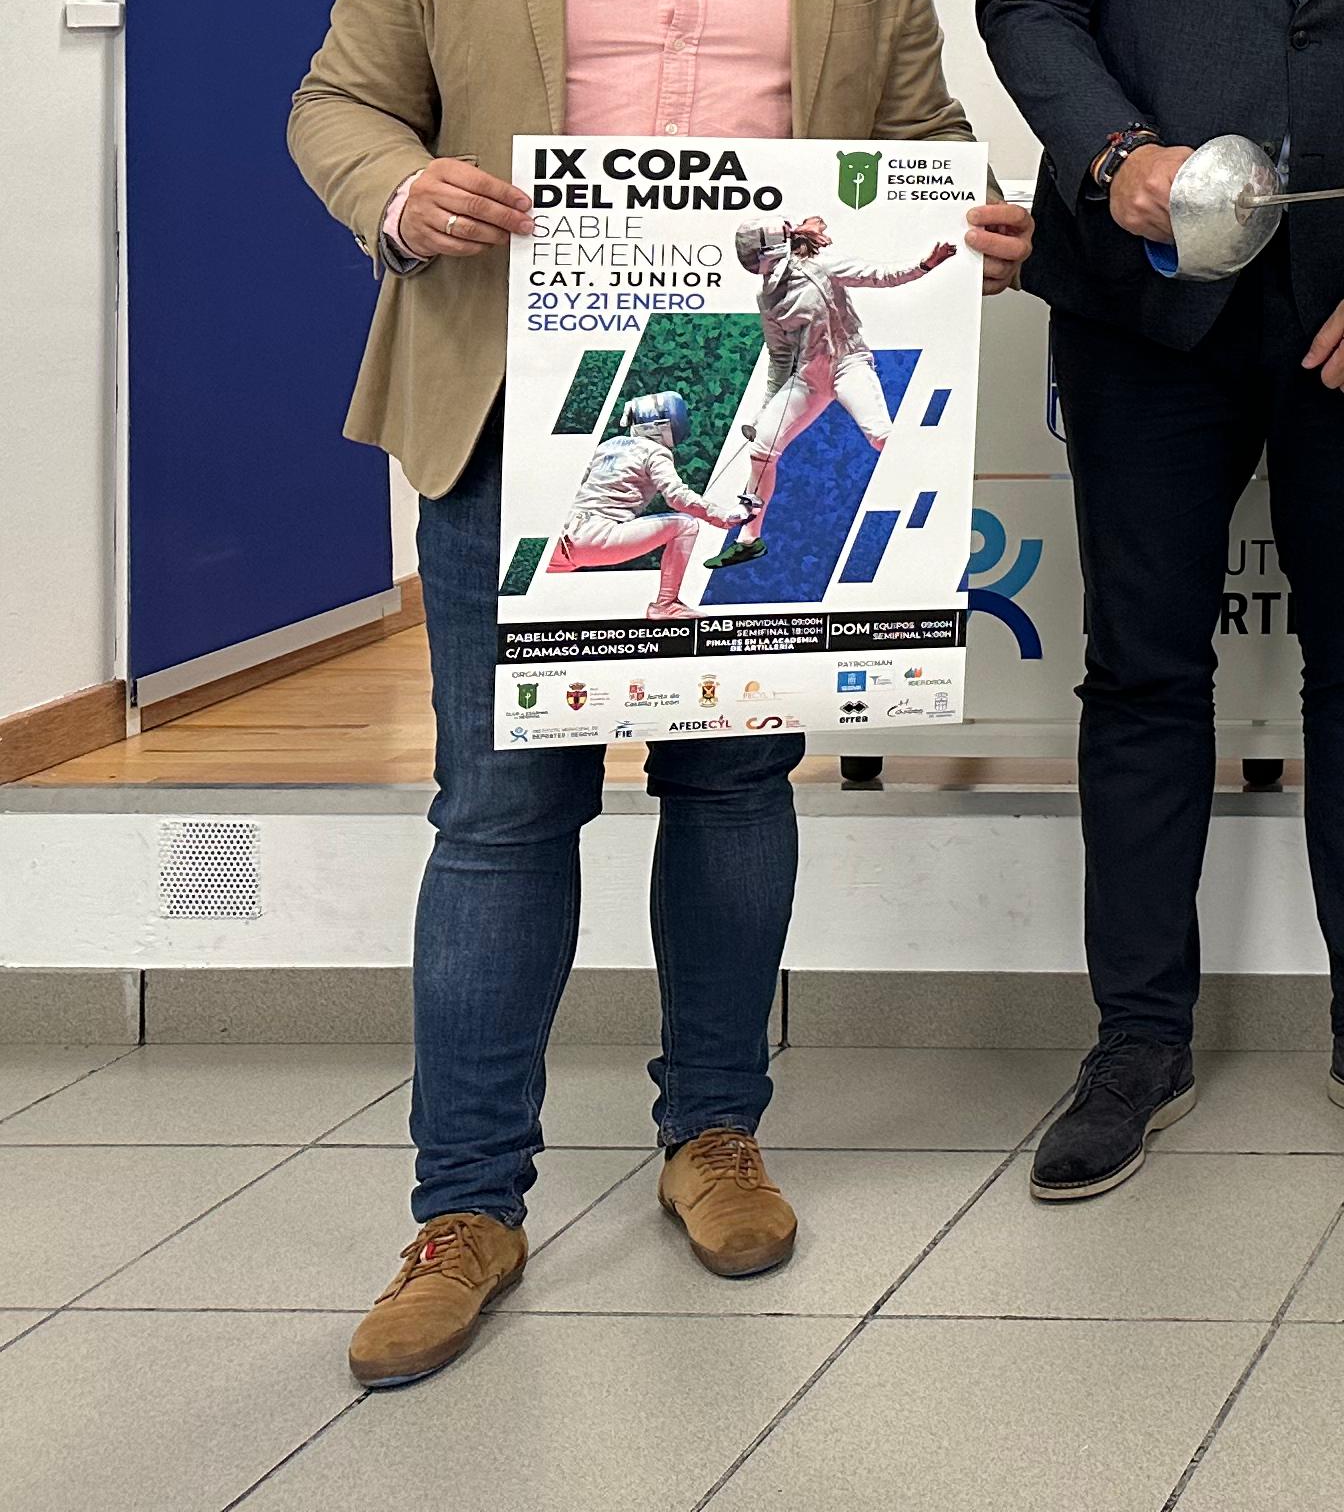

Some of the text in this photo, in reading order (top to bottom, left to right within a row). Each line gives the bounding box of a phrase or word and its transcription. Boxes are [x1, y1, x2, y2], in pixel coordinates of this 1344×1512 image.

[534, 149, 747, 181] IX COPA
[888, 160, 951, 169] CLUB DE
[888, 175, 954, 185] ESGRIMA
[534, 184, 782, 210] DEL MUNDO
[888, 191, 975, 200] DE SEGOVIA
[532, 215, 643, 238] SABLE
[532, 243, 722, 267] FEMENINO
[530, 271, 721, 287] CAT. JUNIOR
[528, 293, 705, 310] 20 Y 21 ENERO
[528, 314, 640, 331] SEGOVIA
[700, 620, 733, 632] SAB
[736, 619, 789, 627] INDIVIDUAL
[831, 622, 870, 636] DOM
[874, 622, 914, 630] EQUIPOS
[507, 628, 690, 643] PABELLÓN: PEDRO DELGADO
[737, 628, 789, 636] SEMIFINAL
[873, 632, 921, 640] SEMIFINAL
[506, 643, 658, 658] C/ DAMASÓ ALONSO S/N
[669, 718, 732, 732] AFEDECYL
[615, 729, 633, 738] FIE
